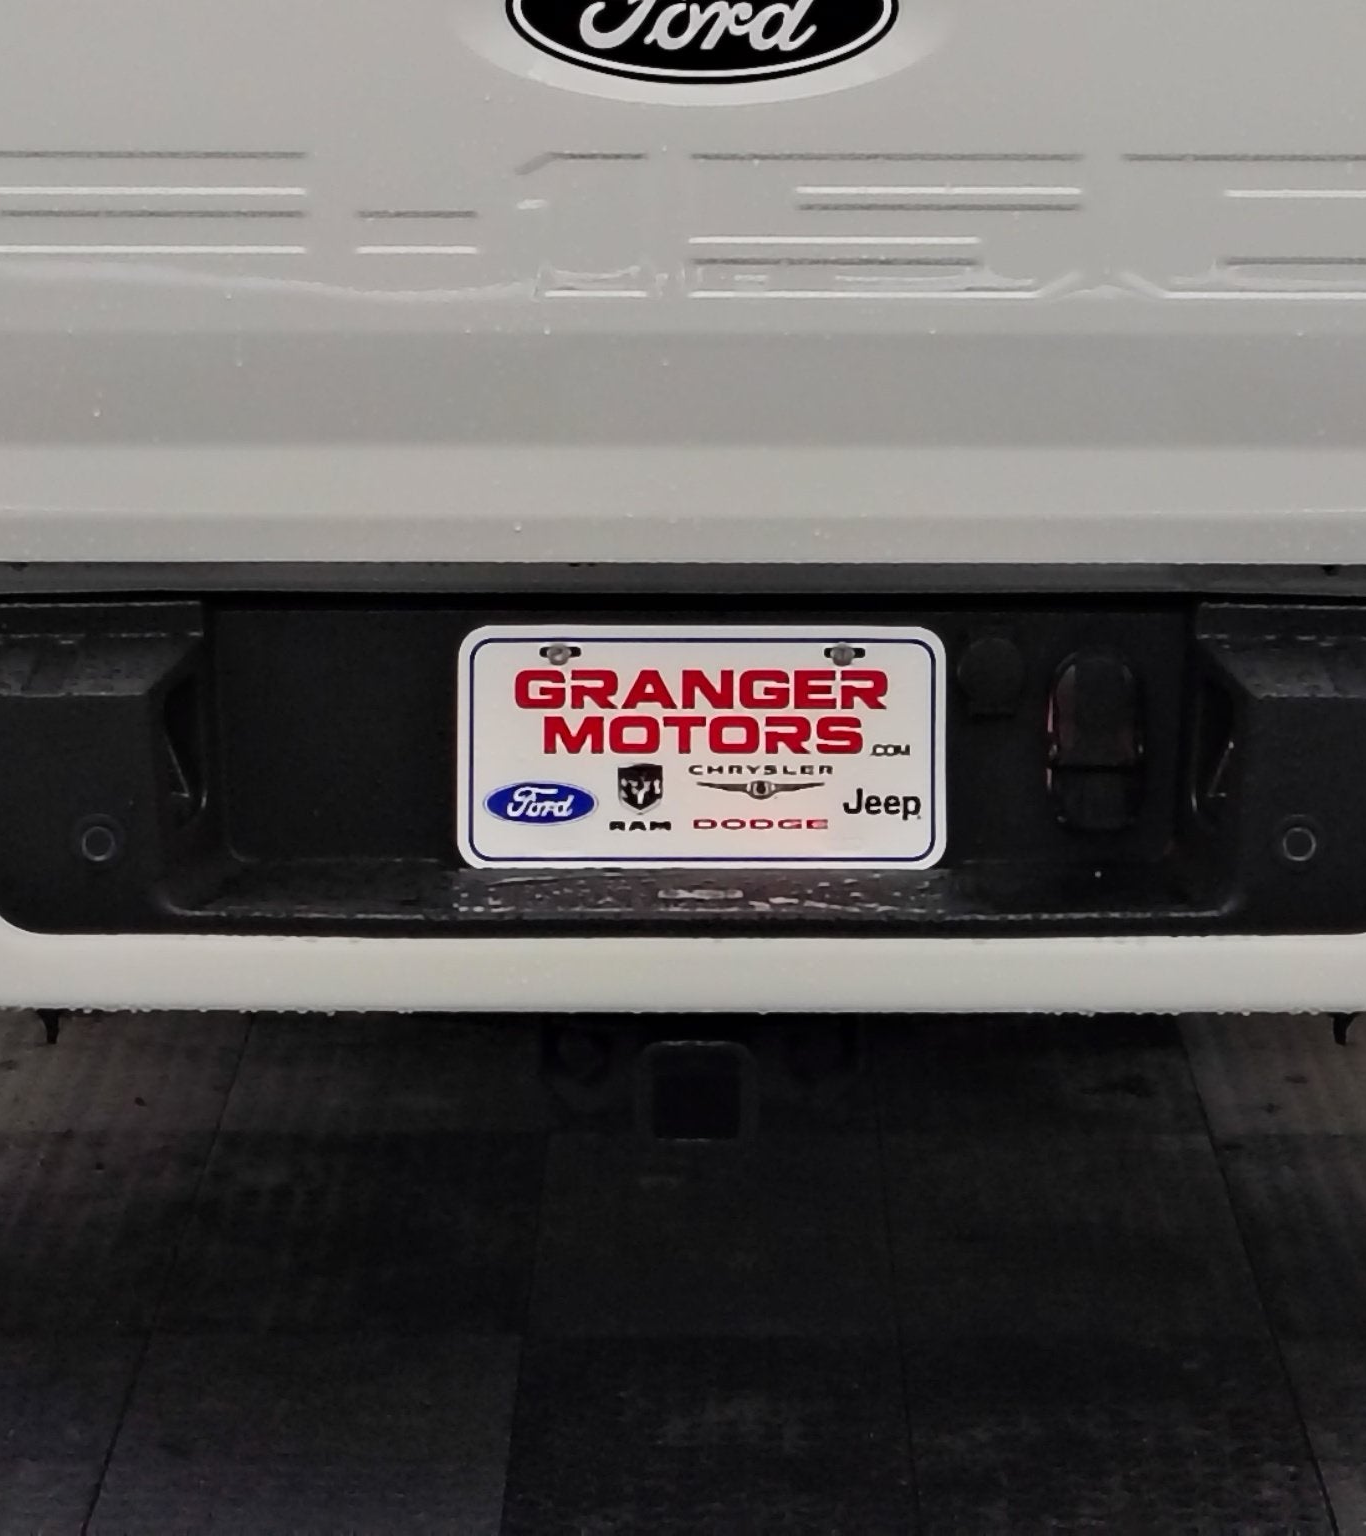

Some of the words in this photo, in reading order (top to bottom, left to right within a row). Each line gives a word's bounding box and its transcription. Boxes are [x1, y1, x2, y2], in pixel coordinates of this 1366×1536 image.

[513, 669, 889, 710] GRANGER
[543, 715, 864, 755] MOTORS
[688, 765, 834, 776] CHRYSLER
[506, 786, 574, 818] Ford
[842, 787, 922, 821] Jeep
[609, 821, 672, 831] RAM
[693, 819, 828, 830] DODGE
